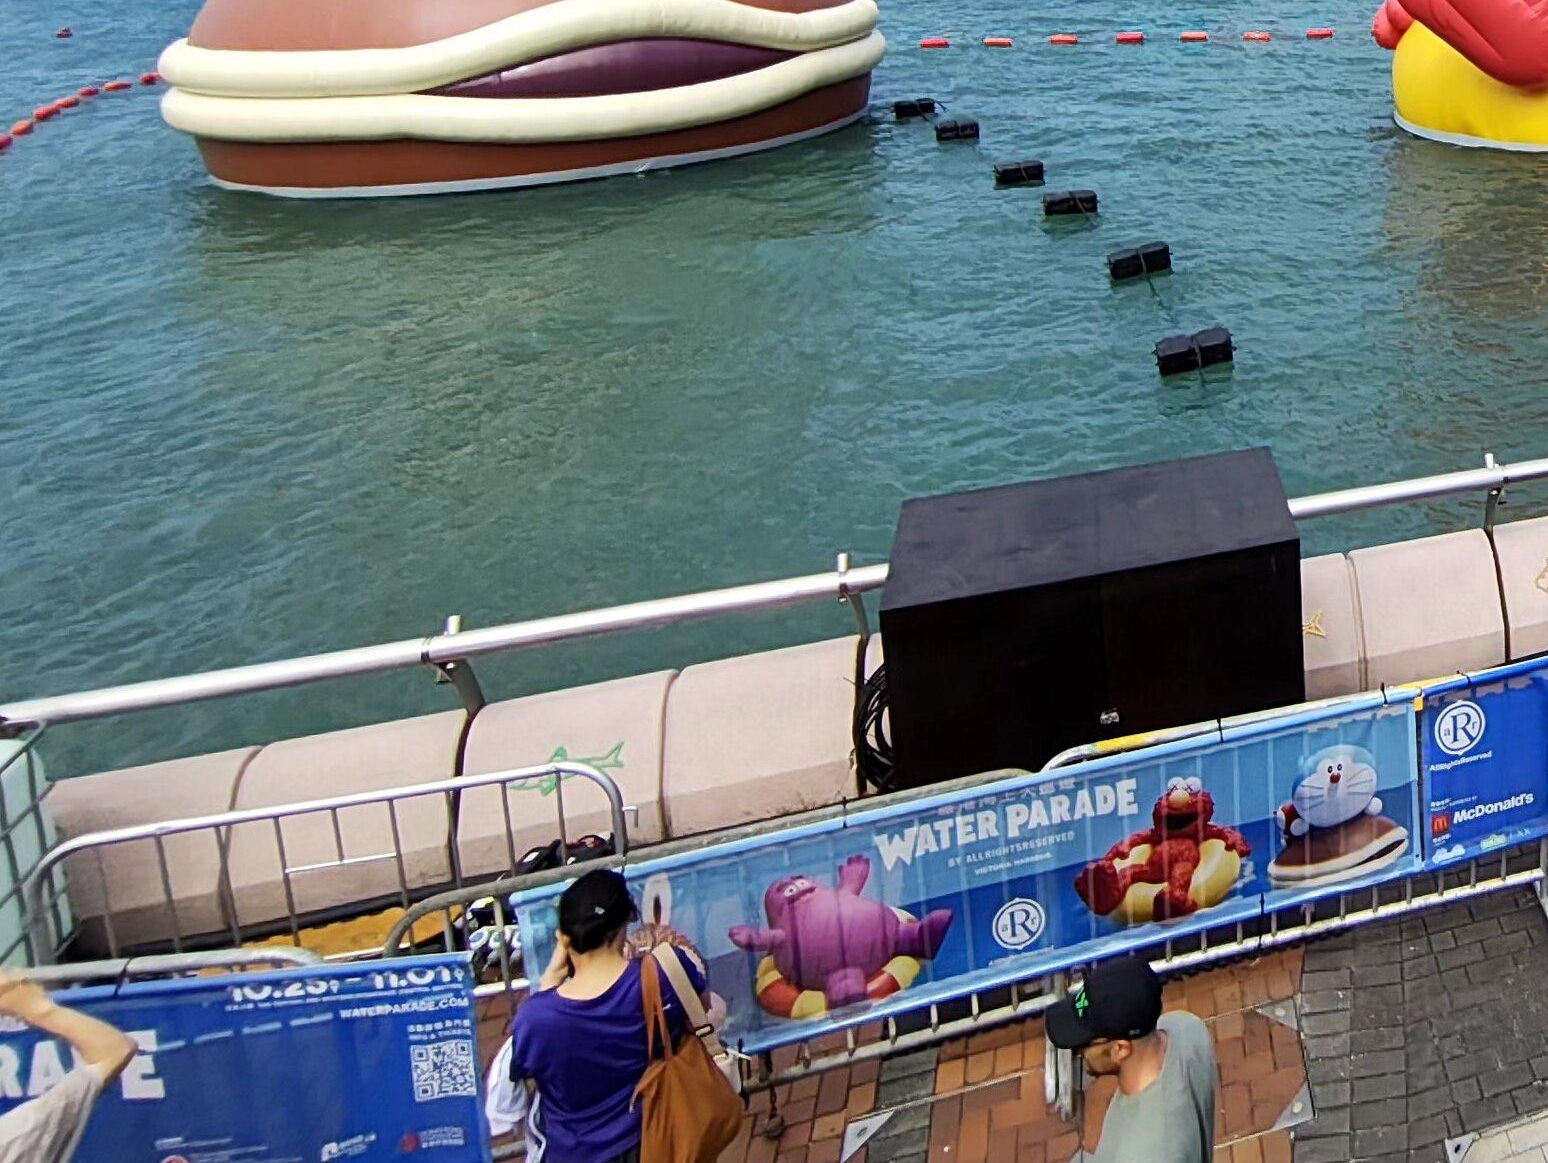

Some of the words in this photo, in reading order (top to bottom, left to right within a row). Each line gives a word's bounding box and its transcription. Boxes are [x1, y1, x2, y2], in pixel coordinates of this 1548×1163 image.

[874, 808, 999, 873] WATER
[1005, 777, 1139, 838] PARADE
[1453, 792, 1535, 825] McDonald's
[965, 830, 1076, 864] ALLRIGHTSRESERVED
